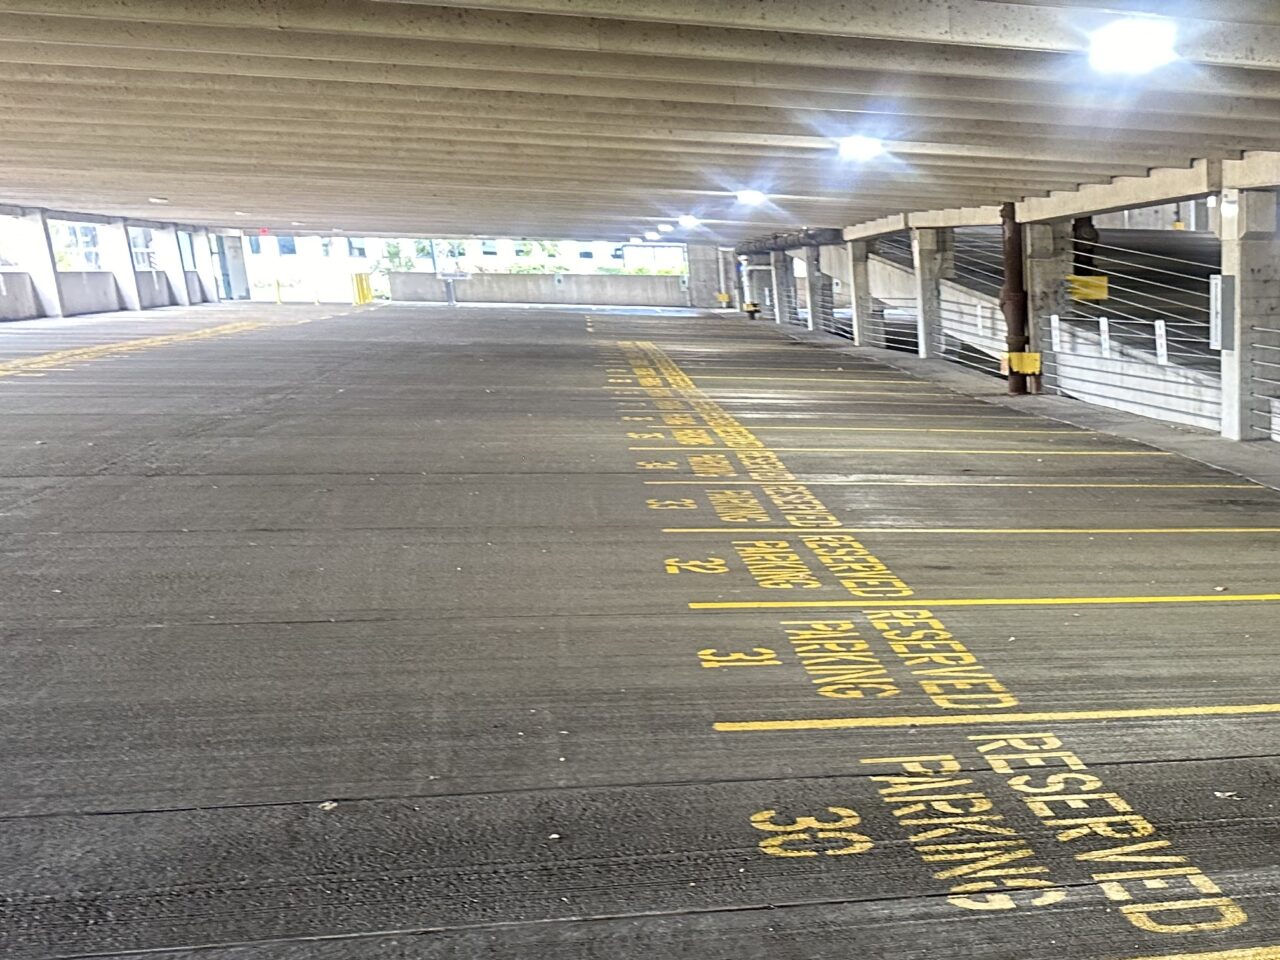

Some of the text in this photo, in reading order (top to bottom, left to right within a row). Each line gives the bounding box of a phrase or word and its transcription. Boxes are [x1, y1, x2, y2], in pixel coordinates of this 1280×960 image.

[645, 498, 698, 510] 33
[705, 490, 772, 522] PARKING
[762, 485, 842, 527] RESERVED
[664, 557, 730, 574] 32
[731, 540, 822, 589] PARKING
[798, 535, 914, 597] RESERVED
[698, 647, 782, 668] 31
[780, 620, 901, 699] PARKING
[863, 609, 1018, 709] RESERVED
[750, 807, 874, 858] 30
[859, 755, 1069, 911] PARKING
[968, 733, 1247, 933] RESERVED
